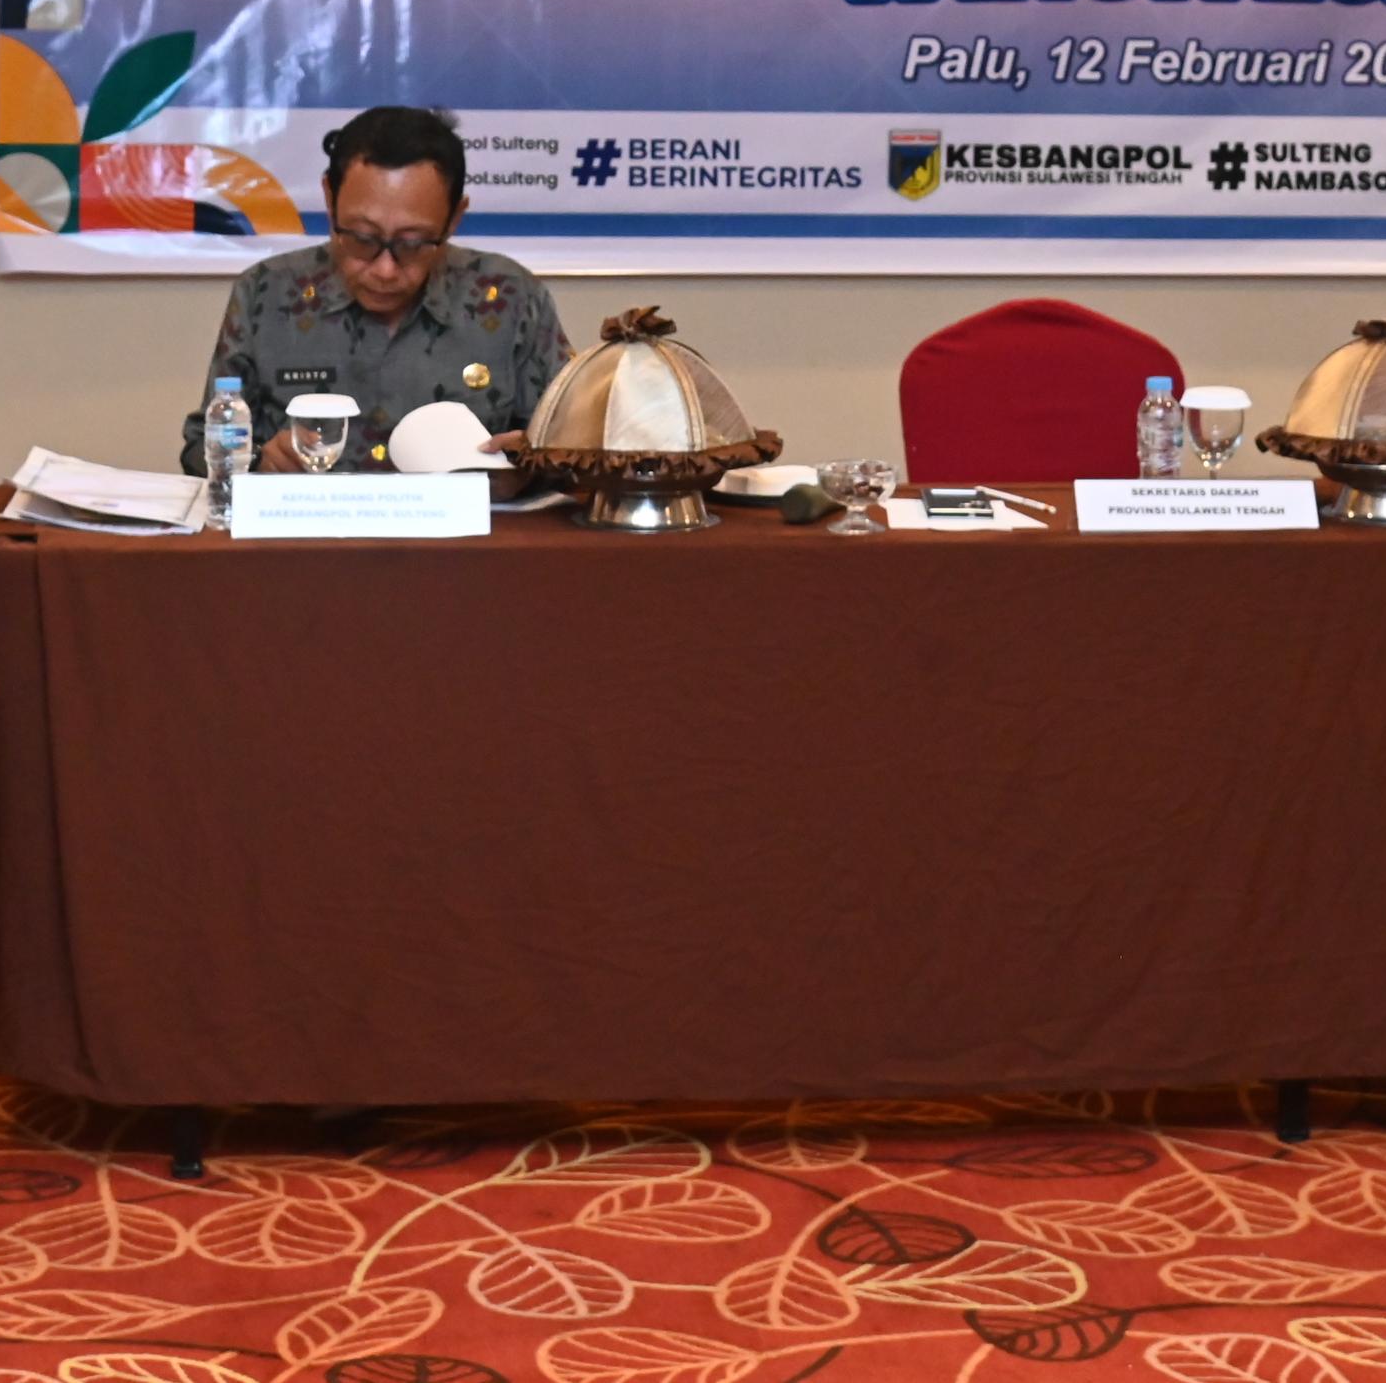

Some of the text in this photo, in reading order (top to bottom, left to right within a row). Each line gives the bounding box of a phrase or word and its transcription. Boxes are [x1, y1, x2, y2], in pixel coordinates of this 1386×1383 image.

[903, 36, 1030, 89] Palu,
[1047, 38, 1106, 82] 12
[1118, 38, 1330, 85] Februari
[492, 136, 558, 155] Sulteng
[628, 138, 742, 161] BERANI
[945, 143, 1192, 170] KESBANGPOL
[1254, 142, 1372, 164] SULTENG
[628, 165, 863, 189] BERINTEGRITAS
[945, 170, 1182, 184] PROVINSI SULAWESI TENGAH
[1131, 487, 1259, 497] SEKRETARIS DAERAH
[1108, 506, 1286, 515] PROVINSI SULAWESI TENGAH
